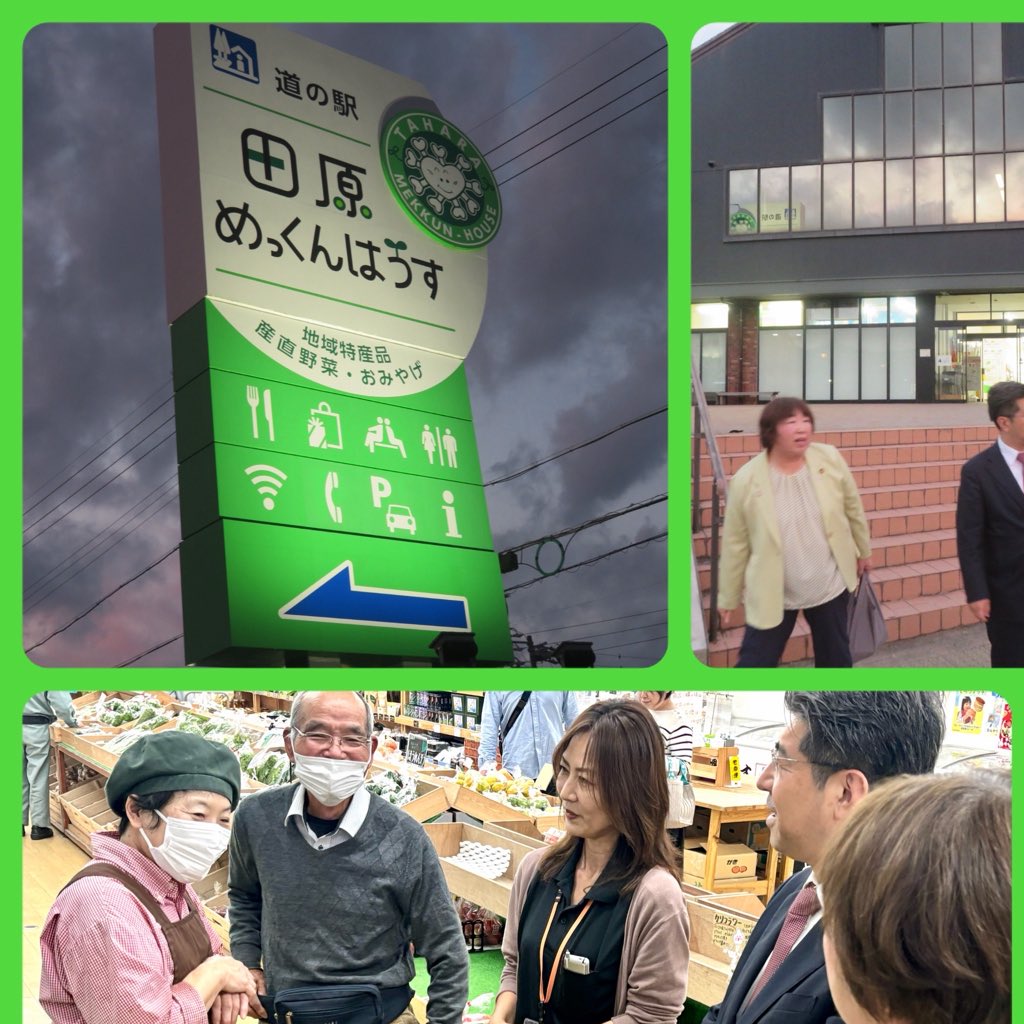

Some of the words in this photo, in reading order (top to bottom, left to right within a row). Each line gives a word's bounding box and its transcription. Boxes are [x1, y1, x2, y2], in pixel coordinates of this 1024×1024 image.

[274, 67, 359, 121] 道の駅
[394, 117, 481, 168] TAHARA
[241, 128, 374, 220] 田原
[214, 199, 443, 300] めっくんはうす
[255, 320, 423, 387] 産直野菜・おみやげ
[302, 326, 392, 365] 地域特産品
